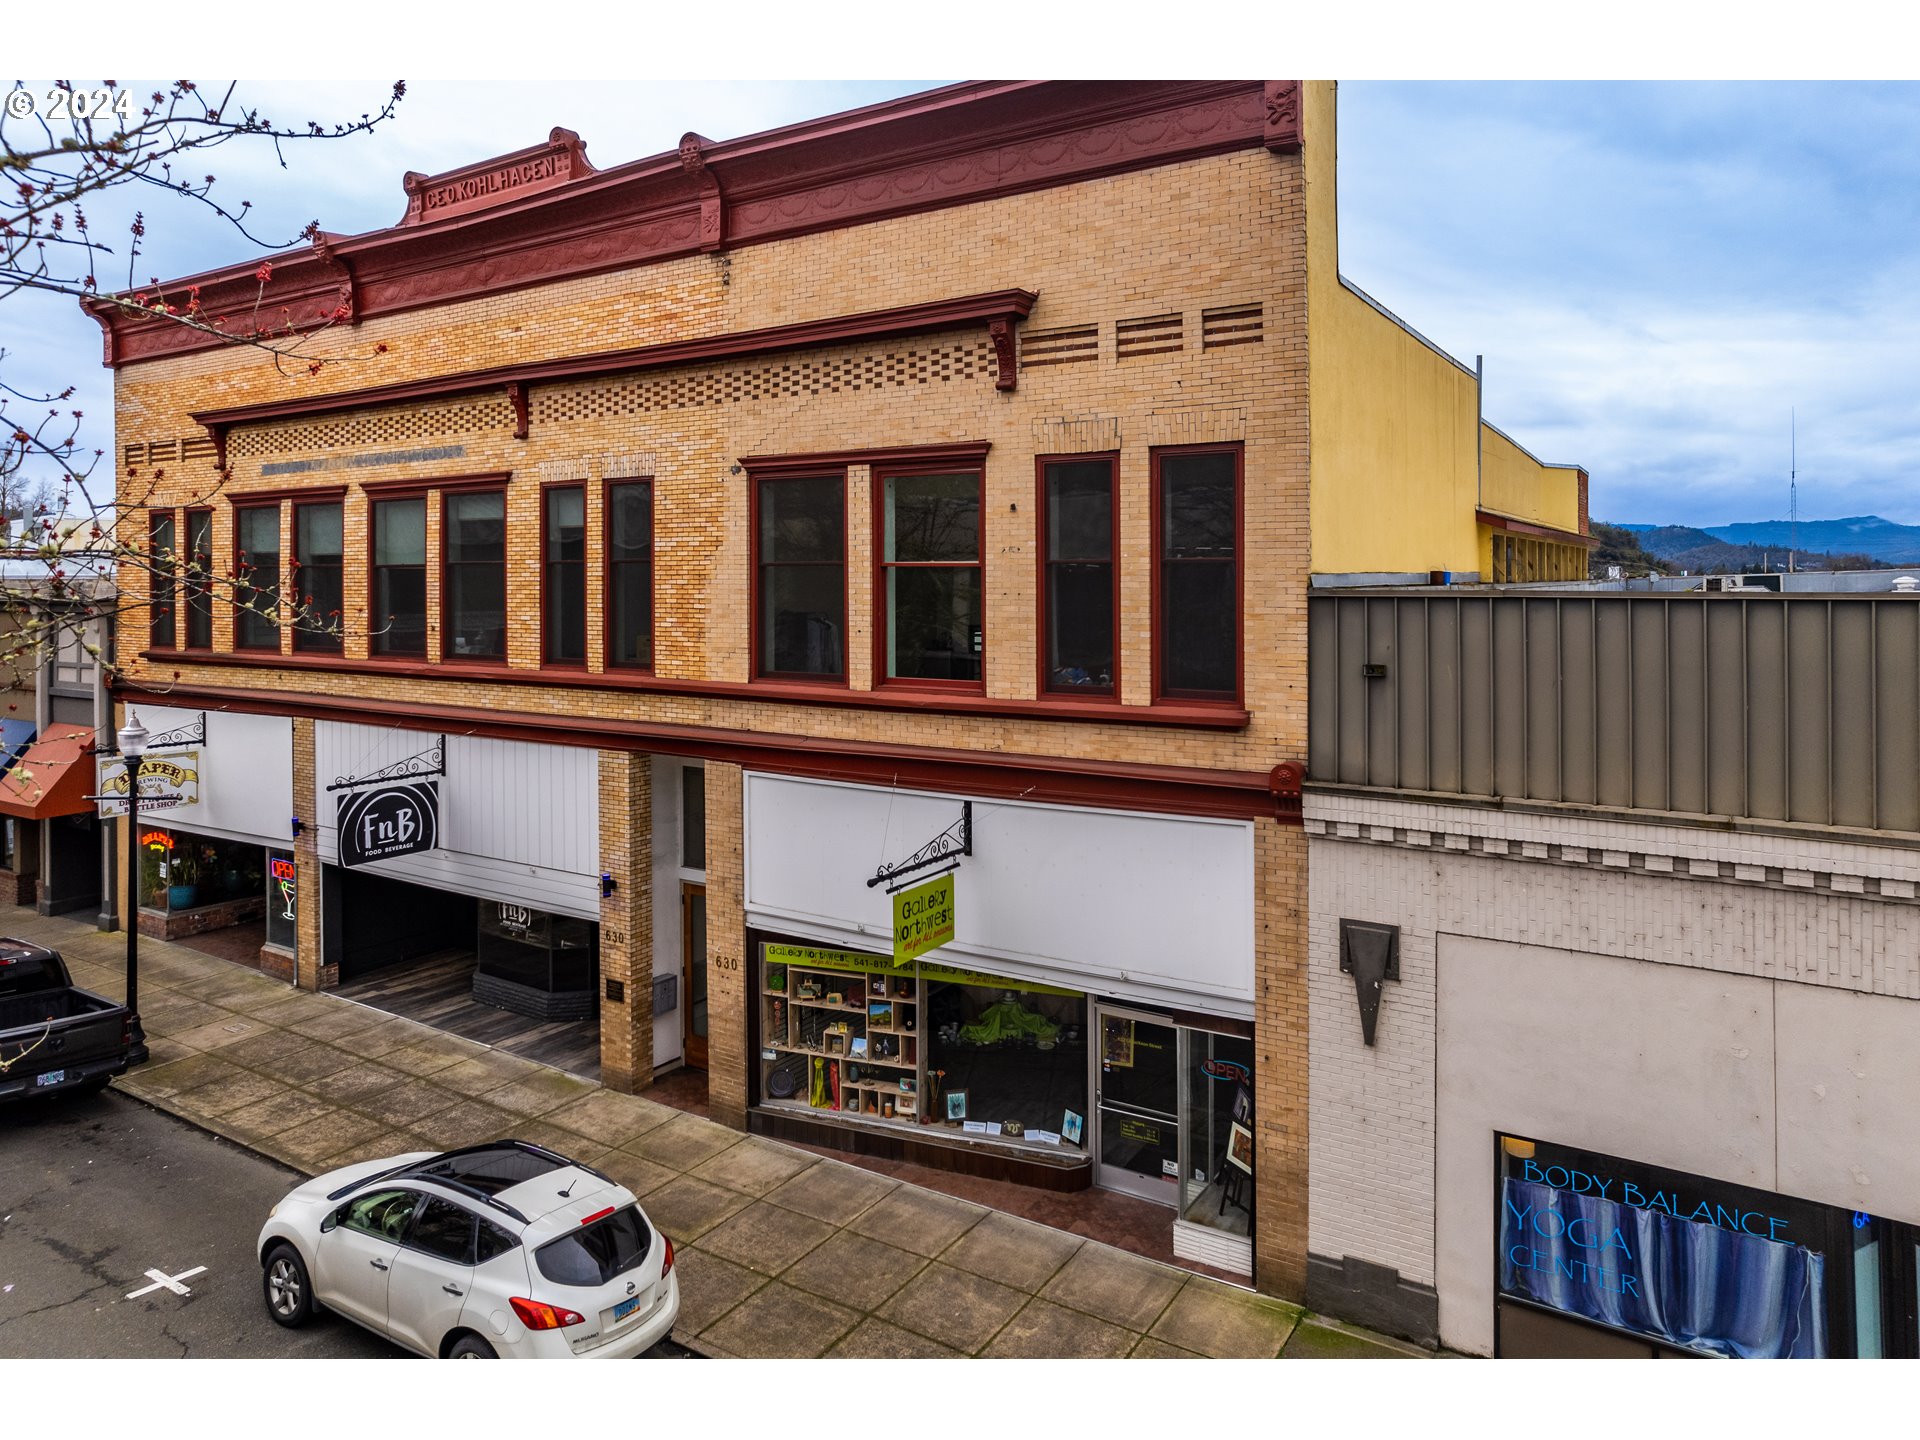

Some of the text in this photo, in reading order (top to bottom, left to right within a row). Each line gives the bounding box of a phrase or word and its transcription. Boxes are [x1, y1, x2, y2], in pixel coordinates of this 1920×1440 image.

[118, 763, 181, 786] DAPER
[156, 800, 178, 809] SHOP
[363, 808, 416, 849] FnB
[365, 842, 414, 857] FOOD BEVERAGE
[273, 860, 295, 879] OPEN
[605, 930, 624, 944] 630
[715, 956, 737, 971] 630
[854, 958, 914, 972] 541-817-784
[1204, 1059, 1246, 1084] OPEN
[1523, 1159, 1796, 1245] BODY BALANCE
[1506, 1199, 1633, 1260] YOGA
[1509, 1244, 1640, 1299] CENTER
